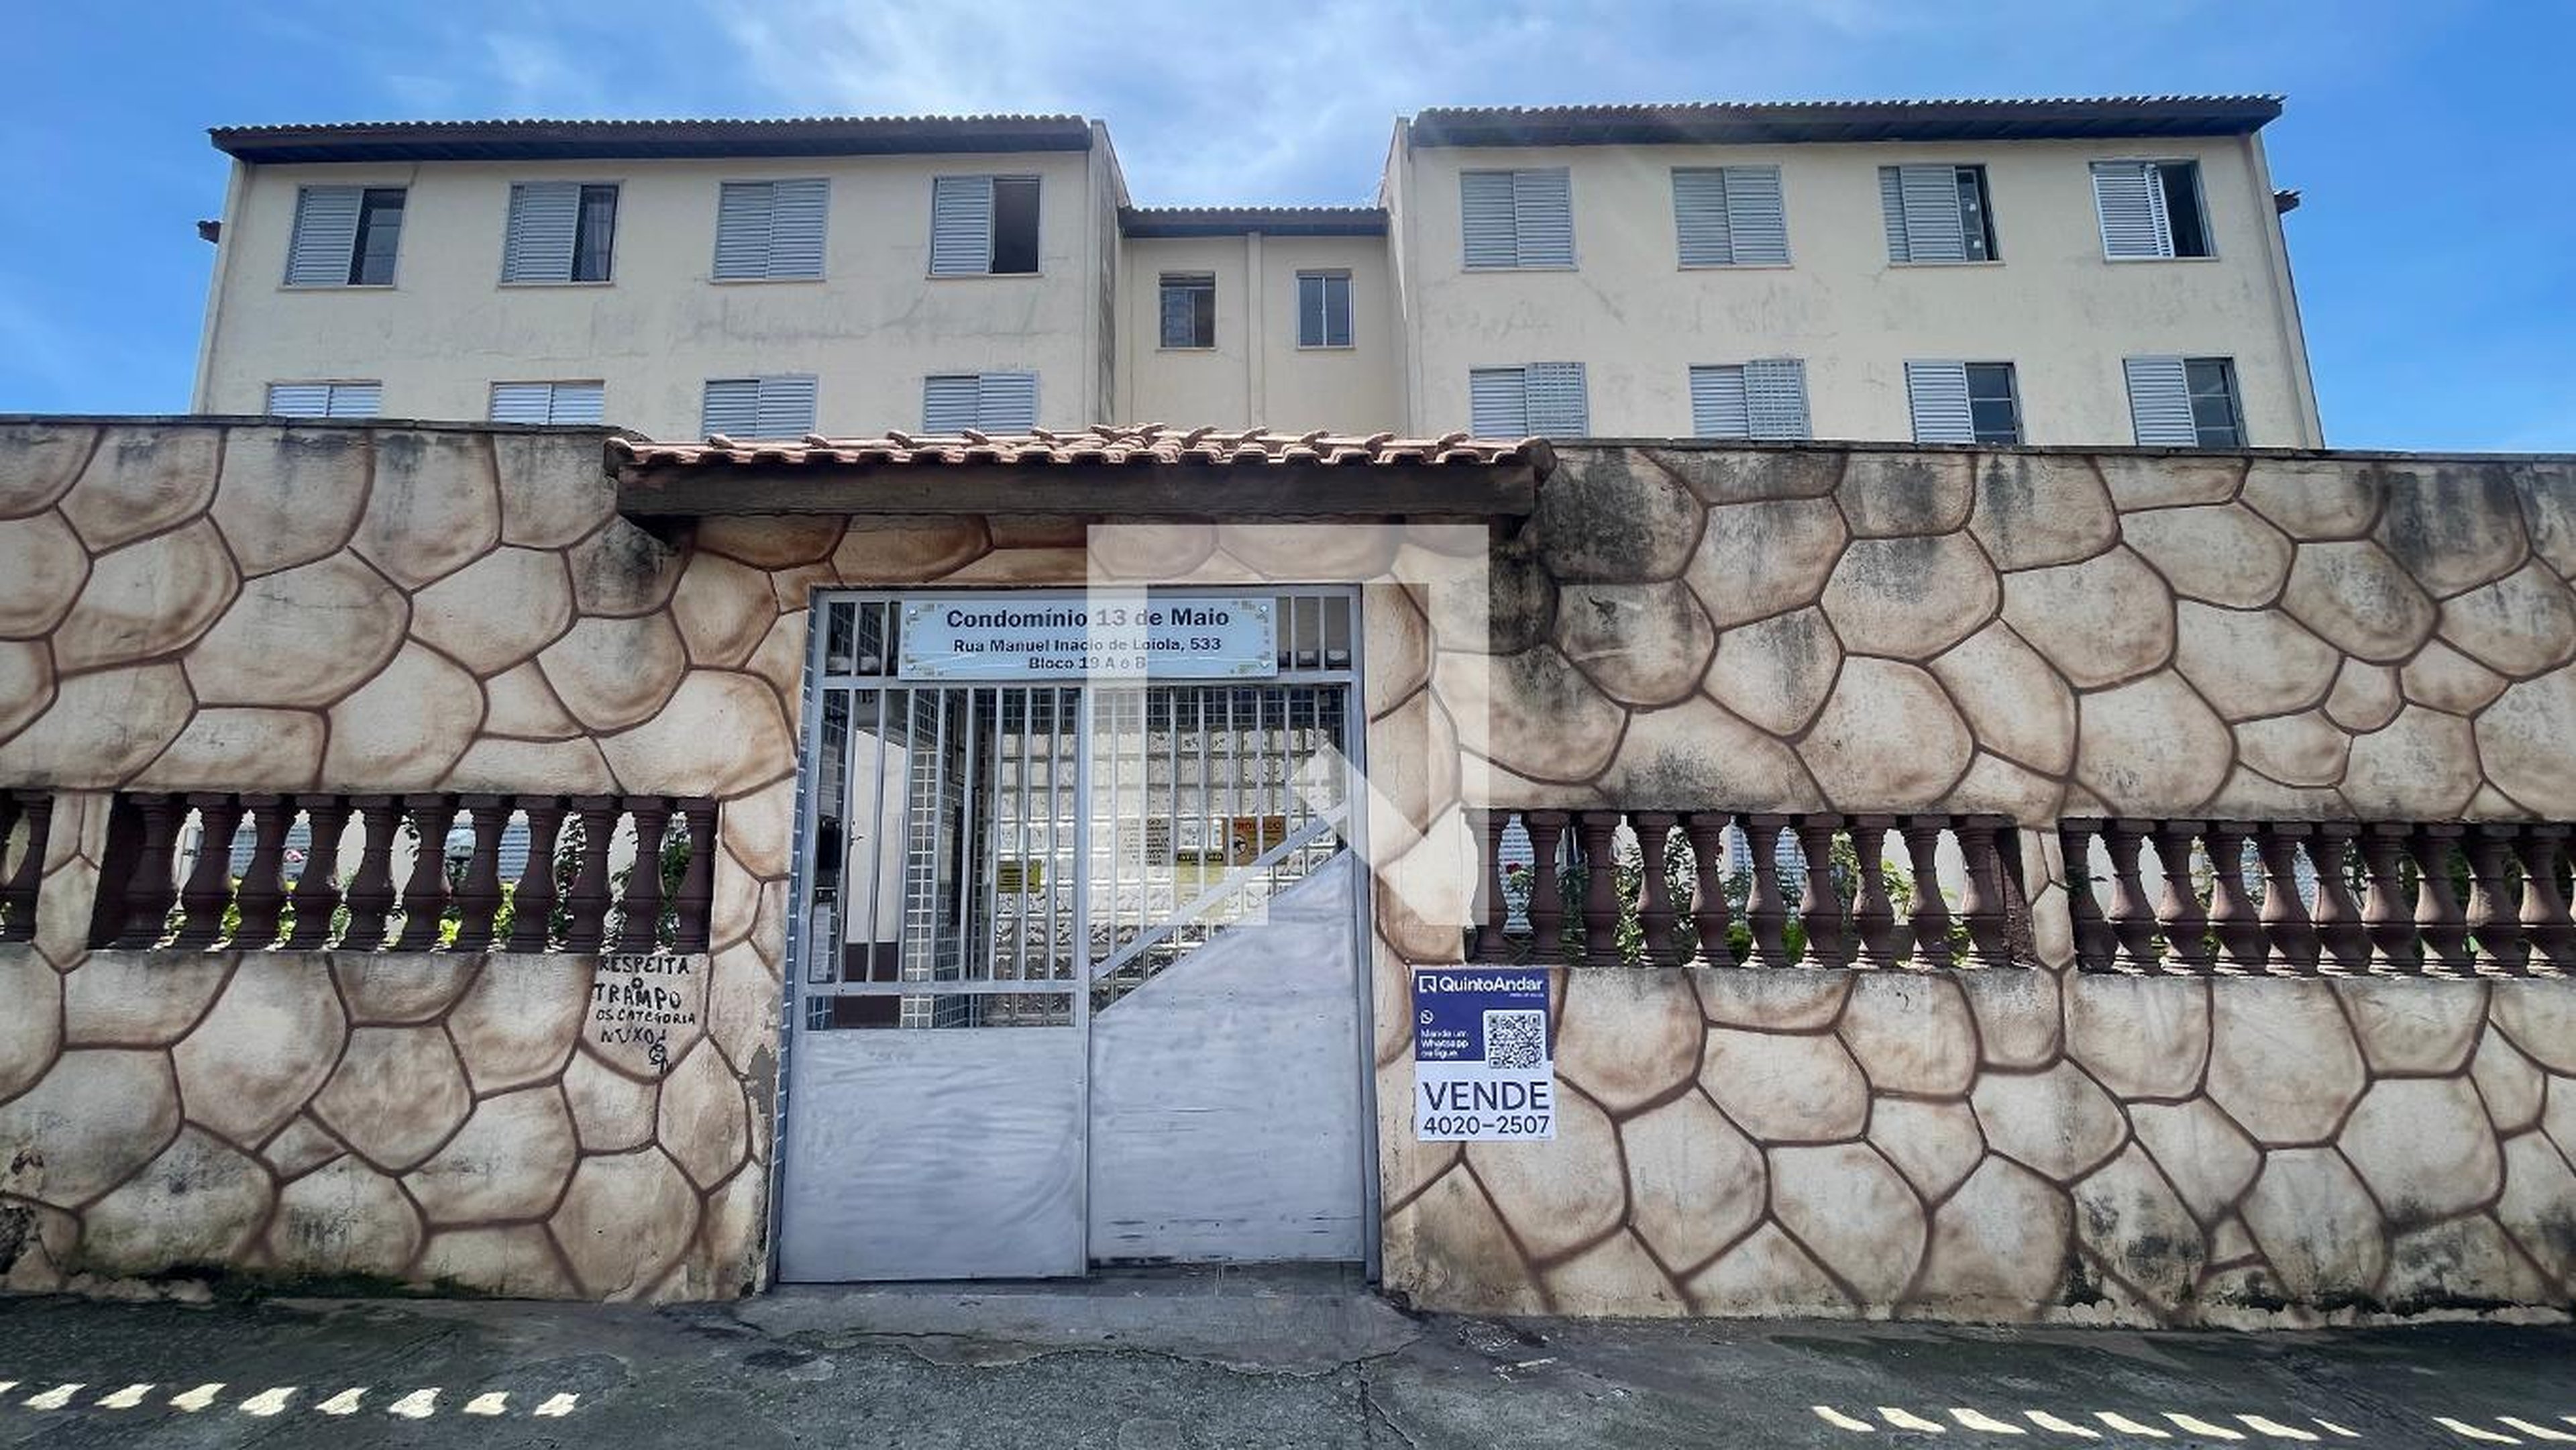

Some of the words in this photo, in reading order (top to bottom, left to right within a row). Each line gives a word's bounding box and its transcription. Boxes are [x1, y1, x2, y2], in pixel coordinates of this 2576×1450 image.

[947, 607, 1087, 627] Condomínio
[1095, 609, 1126, 627] 13
[1134, 609, 1163, 626] de
[1171, 607, 1230, 626] Maio
[953, 639, 985, 652] Rua
[989, 639, 1050, 652] Manuel
[1108, 638, 1128, 651] de
[1133, 637, 1185, 653] Loiola,
[1189, 637, 1222, 651] 533
[1028, 657, 1075, 670] Bloco
[599, 955, 690, 974] RESPEITA
[1439, 976, 1543, 992] QuintoAndar
[594, 983, 682, 1011] TRAMPO
[1422, 1081, 1550, 1111] VENDE
[1424, 1115, 1550, 1135] 4020-2507
